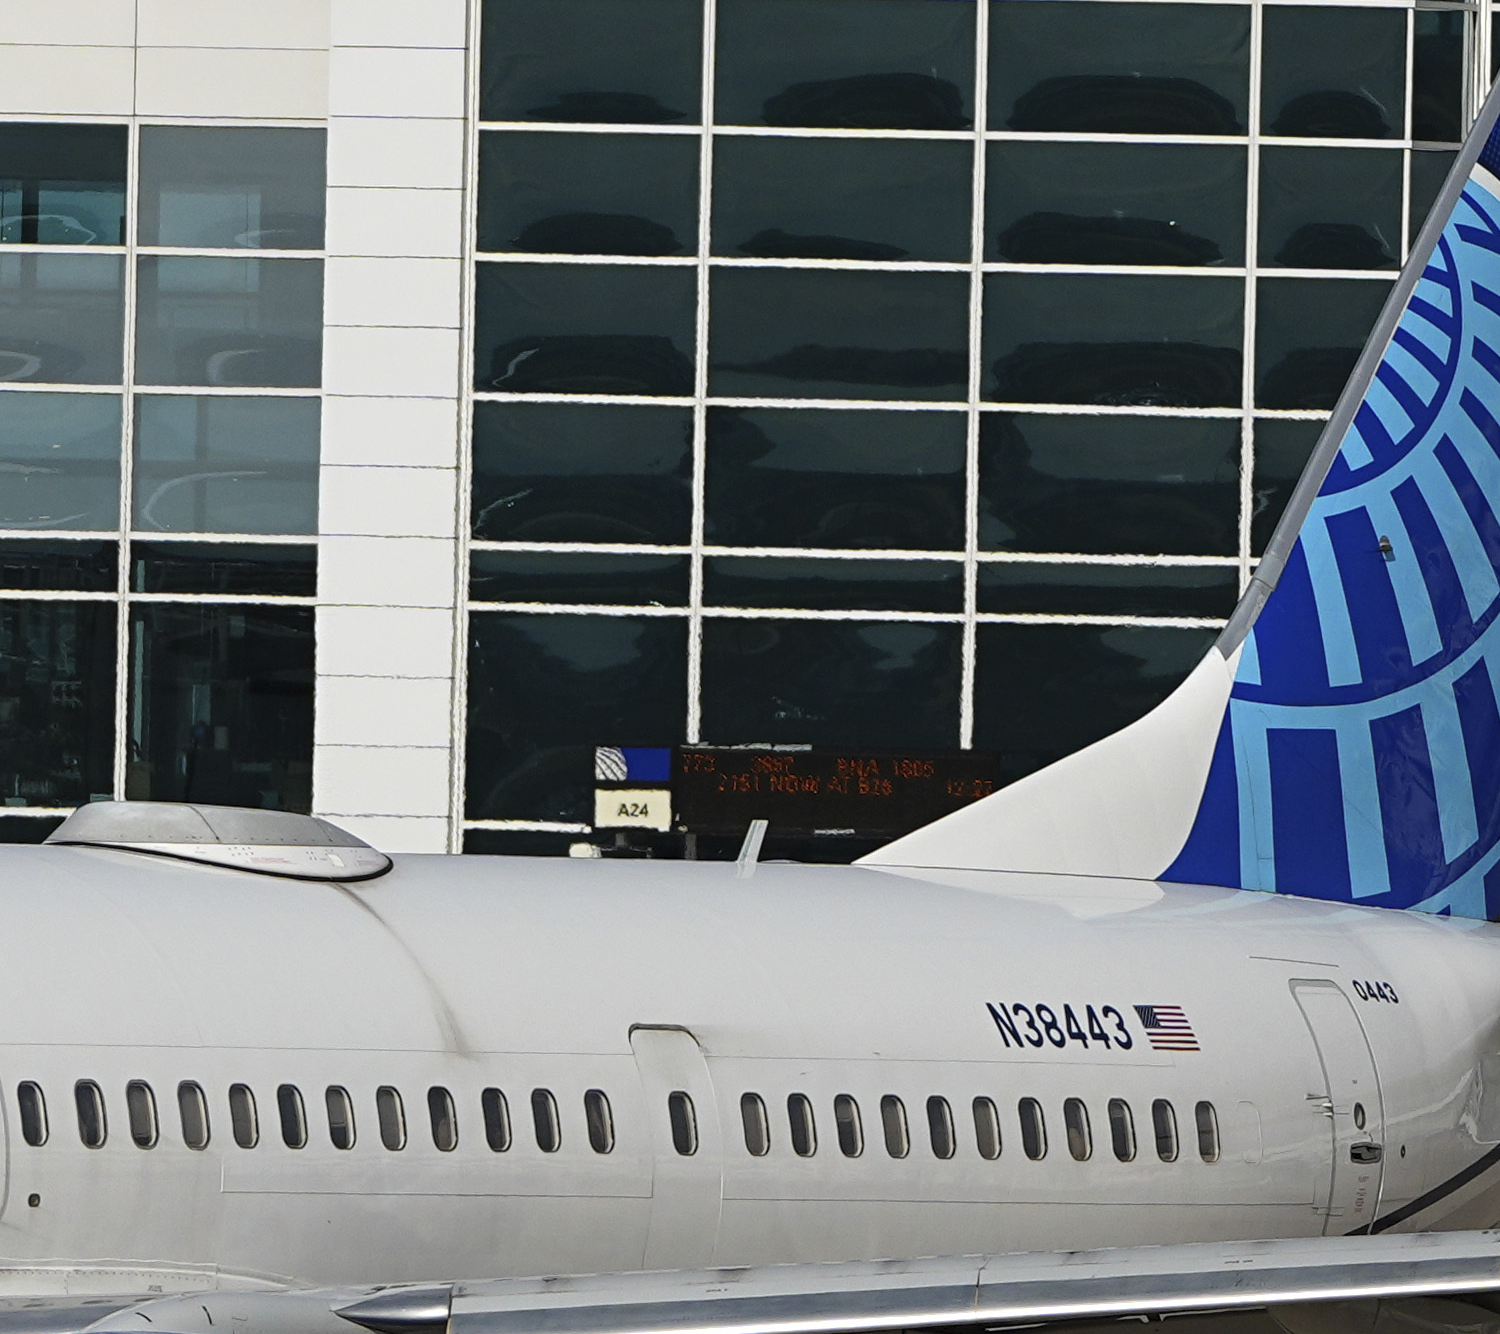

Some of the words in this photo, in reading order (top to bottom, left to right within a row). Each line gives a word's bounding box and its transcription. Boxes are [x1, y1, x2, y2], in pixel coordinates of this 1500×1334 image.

[617, 802, 649, 818] A24
[1352, 979, 1399, 1004] 0443
[985, 1002, 1133, 1050] N38443
